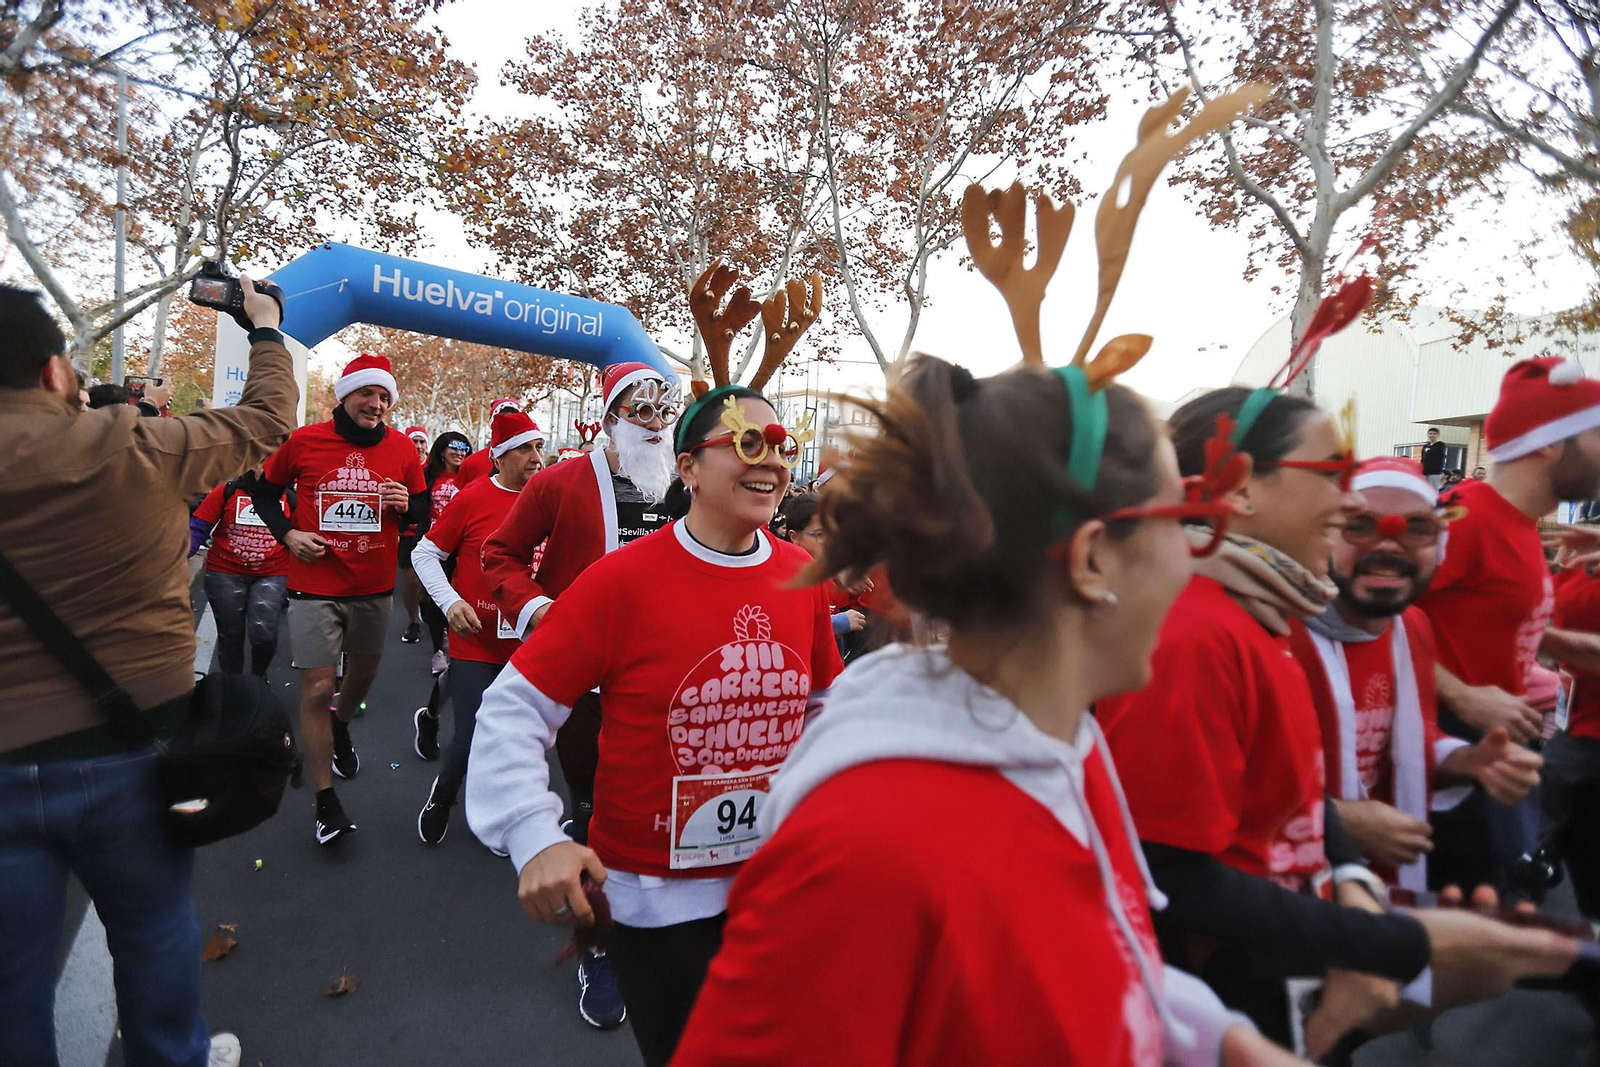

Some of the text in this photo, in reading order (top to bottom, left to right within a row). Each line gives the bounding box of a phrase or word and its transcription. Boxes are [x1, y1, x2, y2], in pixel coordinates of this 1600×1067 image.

[372, 263, 603, 337] Huelva original
[336, 467, 371, 480] XIII
[334, 502, 366, 519] 447
[719, 642, 785, 672] XIII
[680, 669, 811, 707] CARRERA
[716, 795, 757, 835] 94
